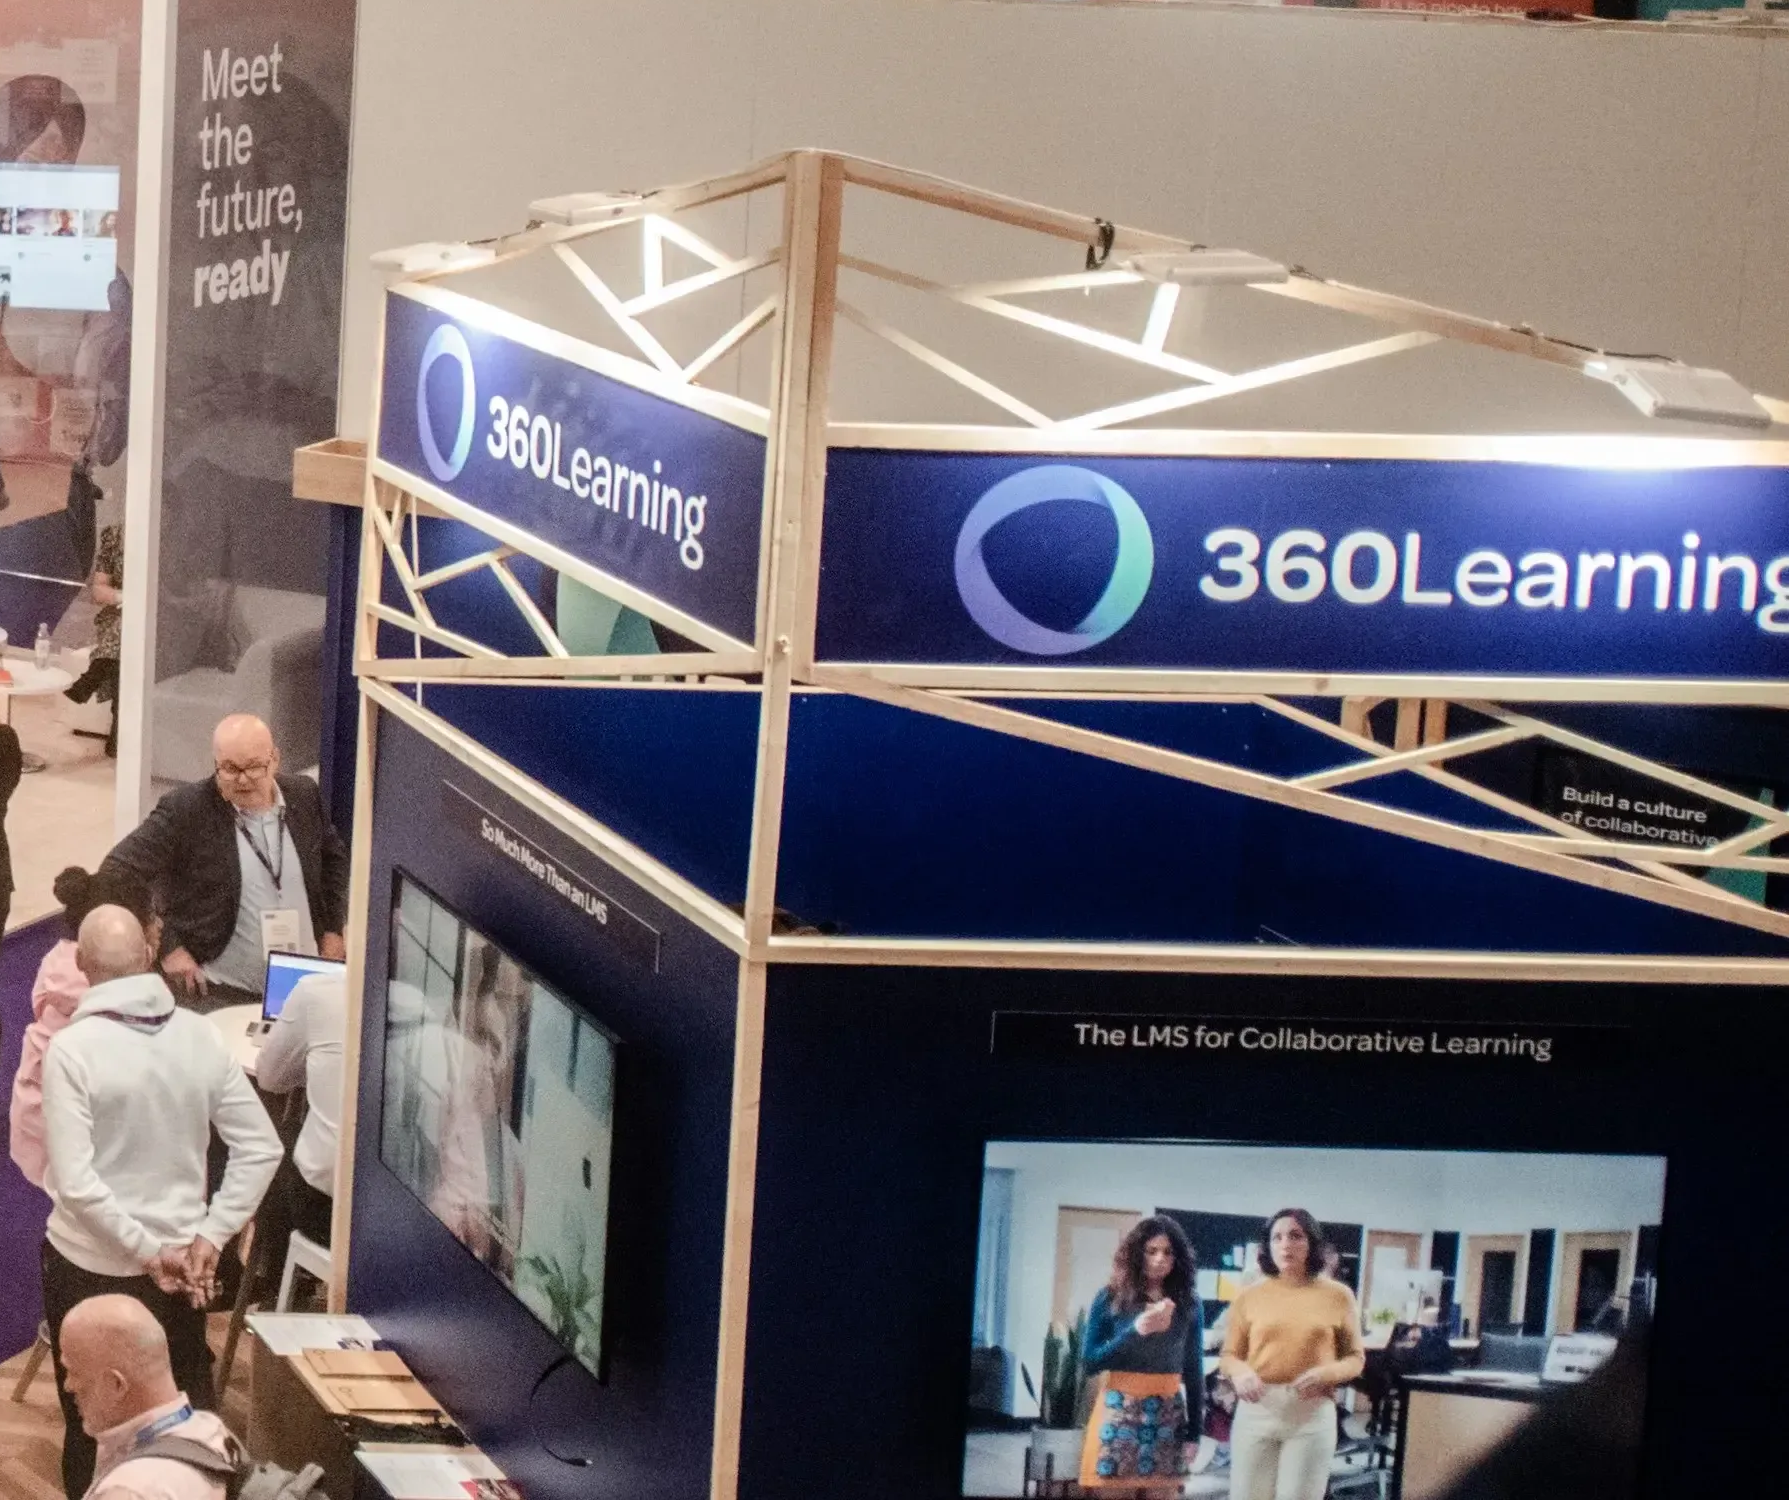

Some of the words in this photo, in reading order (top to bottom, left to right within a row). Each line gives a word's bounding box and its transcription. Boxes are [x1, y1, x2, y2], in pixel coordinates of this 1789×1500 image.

[200, 41, 284, 101] Meet
[198, 112, 253, 171] the
[195, 178, 304, 240] future,
[193, 247, 291, 308] ready
[486, 394, 708, 571] 360Learning
[1198, 530, 1789, 634] 360Learning
[1560, 810, 1583, 825] of
[1584, 814, 1719, 847] collaborative
[1562, 785, 1614, 808] Build
[1617, 797, 1630, 812] a
[1633, 801, 1708, 824] culture
[481, 817, 495, 842] So
[494, 826, 522, 862] Much
[521, 845, 546, 879] More
[545, 863, 571, 898] Than
[571, 885, 584, 909] an
[585, 891, 608, 925] LMS
[1074, 1021, 1126, 1048] The
[1131, 1024, 1190, 1049] LMS
[1193, 1023, 1234, 1049] for
[1239, 1026, 1426, 1054] Collaborative
[1430, 1030, 1554, 1063] Learning
